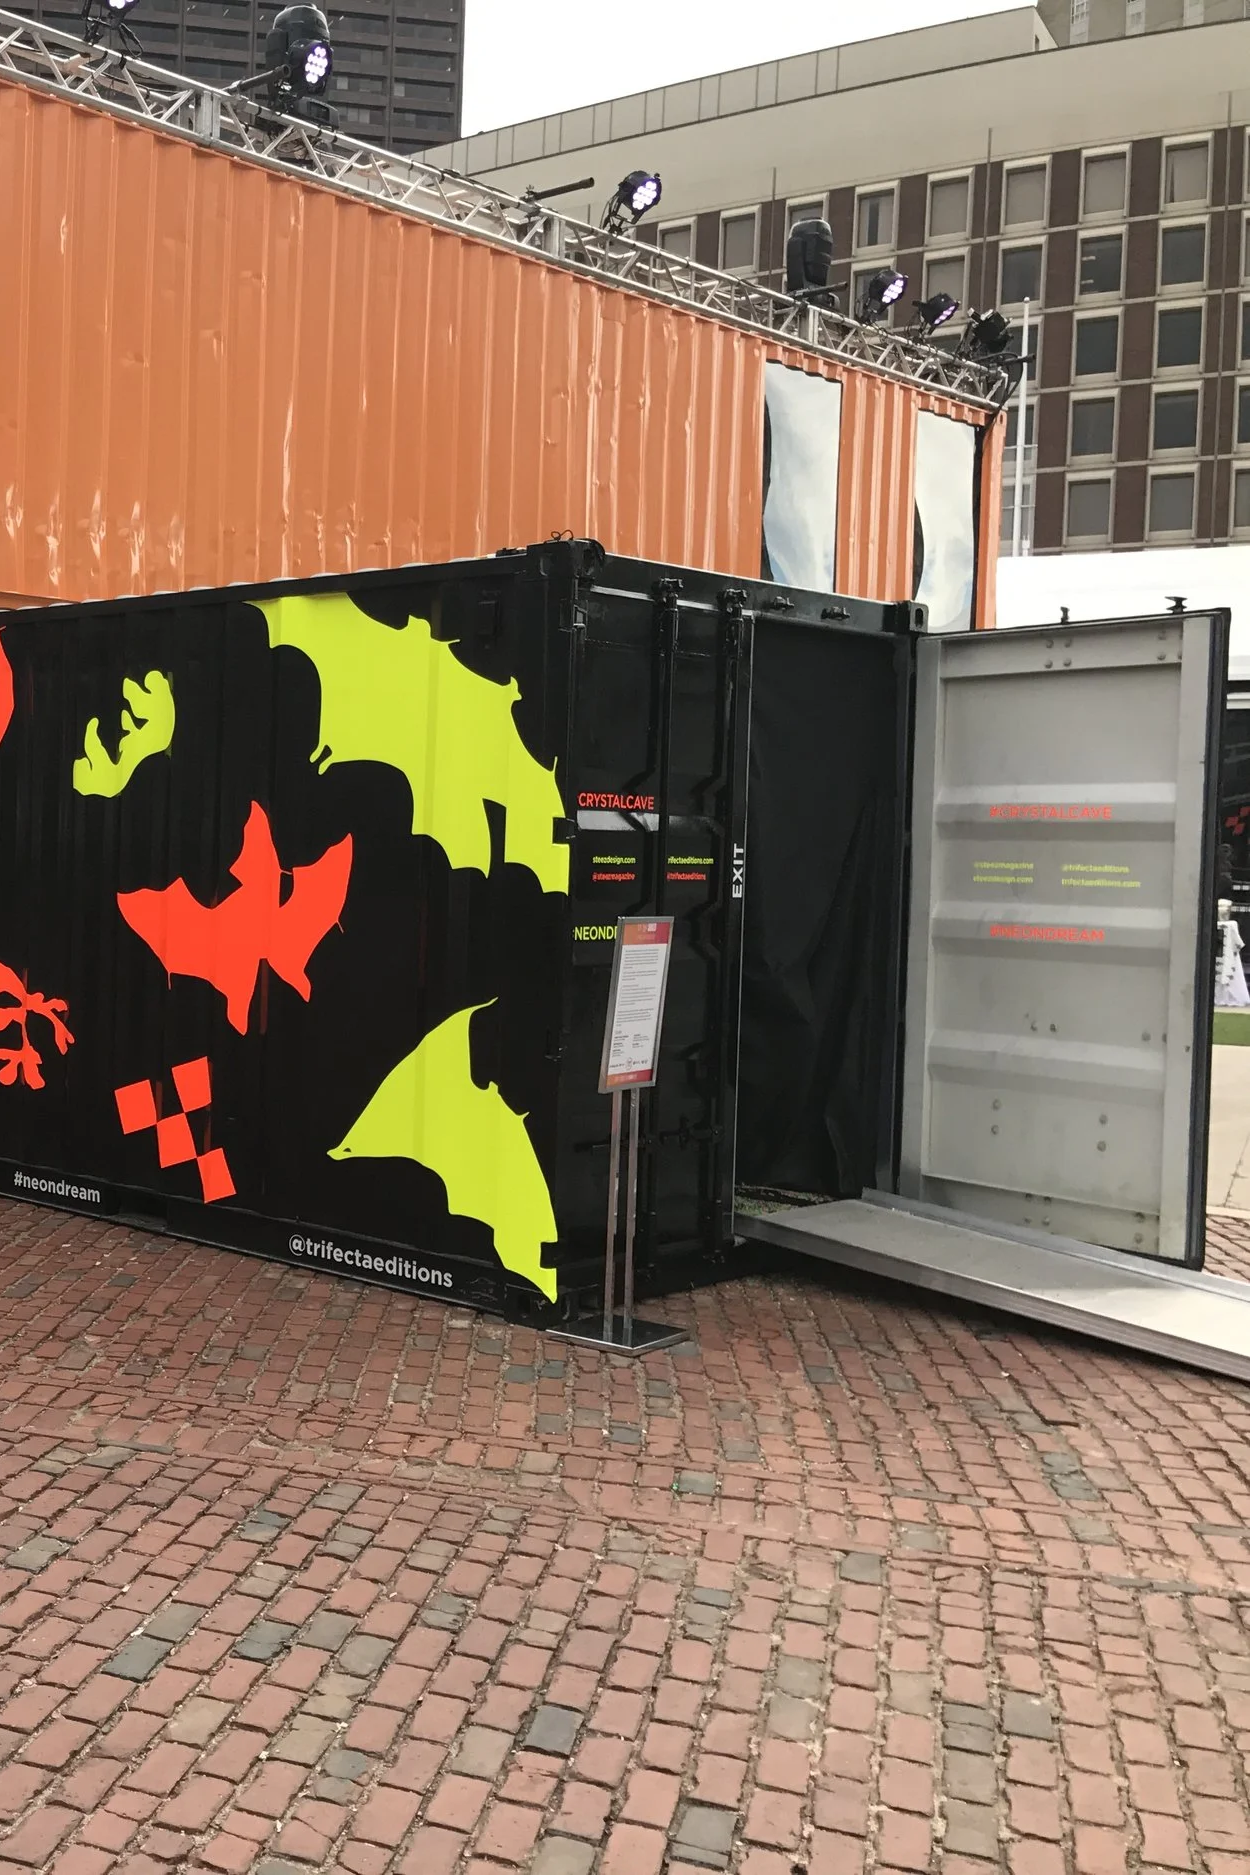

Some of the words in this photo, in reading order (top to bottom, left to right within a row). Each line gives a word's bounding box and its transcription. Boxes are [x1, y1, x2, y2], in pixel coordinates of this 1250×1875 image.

[577, 792, 655, 810] CRYSTALCAVE
[667, 856, 714, 865] rifectaeditions.com
[732, 843, 744, 898] EXIT
[572, 925, 617, 941] NEOND
[990, 925, 1105, 942] #NEONDREAM
[13, 1171, 100, 1203] #neondream
[288, 1234, 453, 1288] @trifectaeditions
